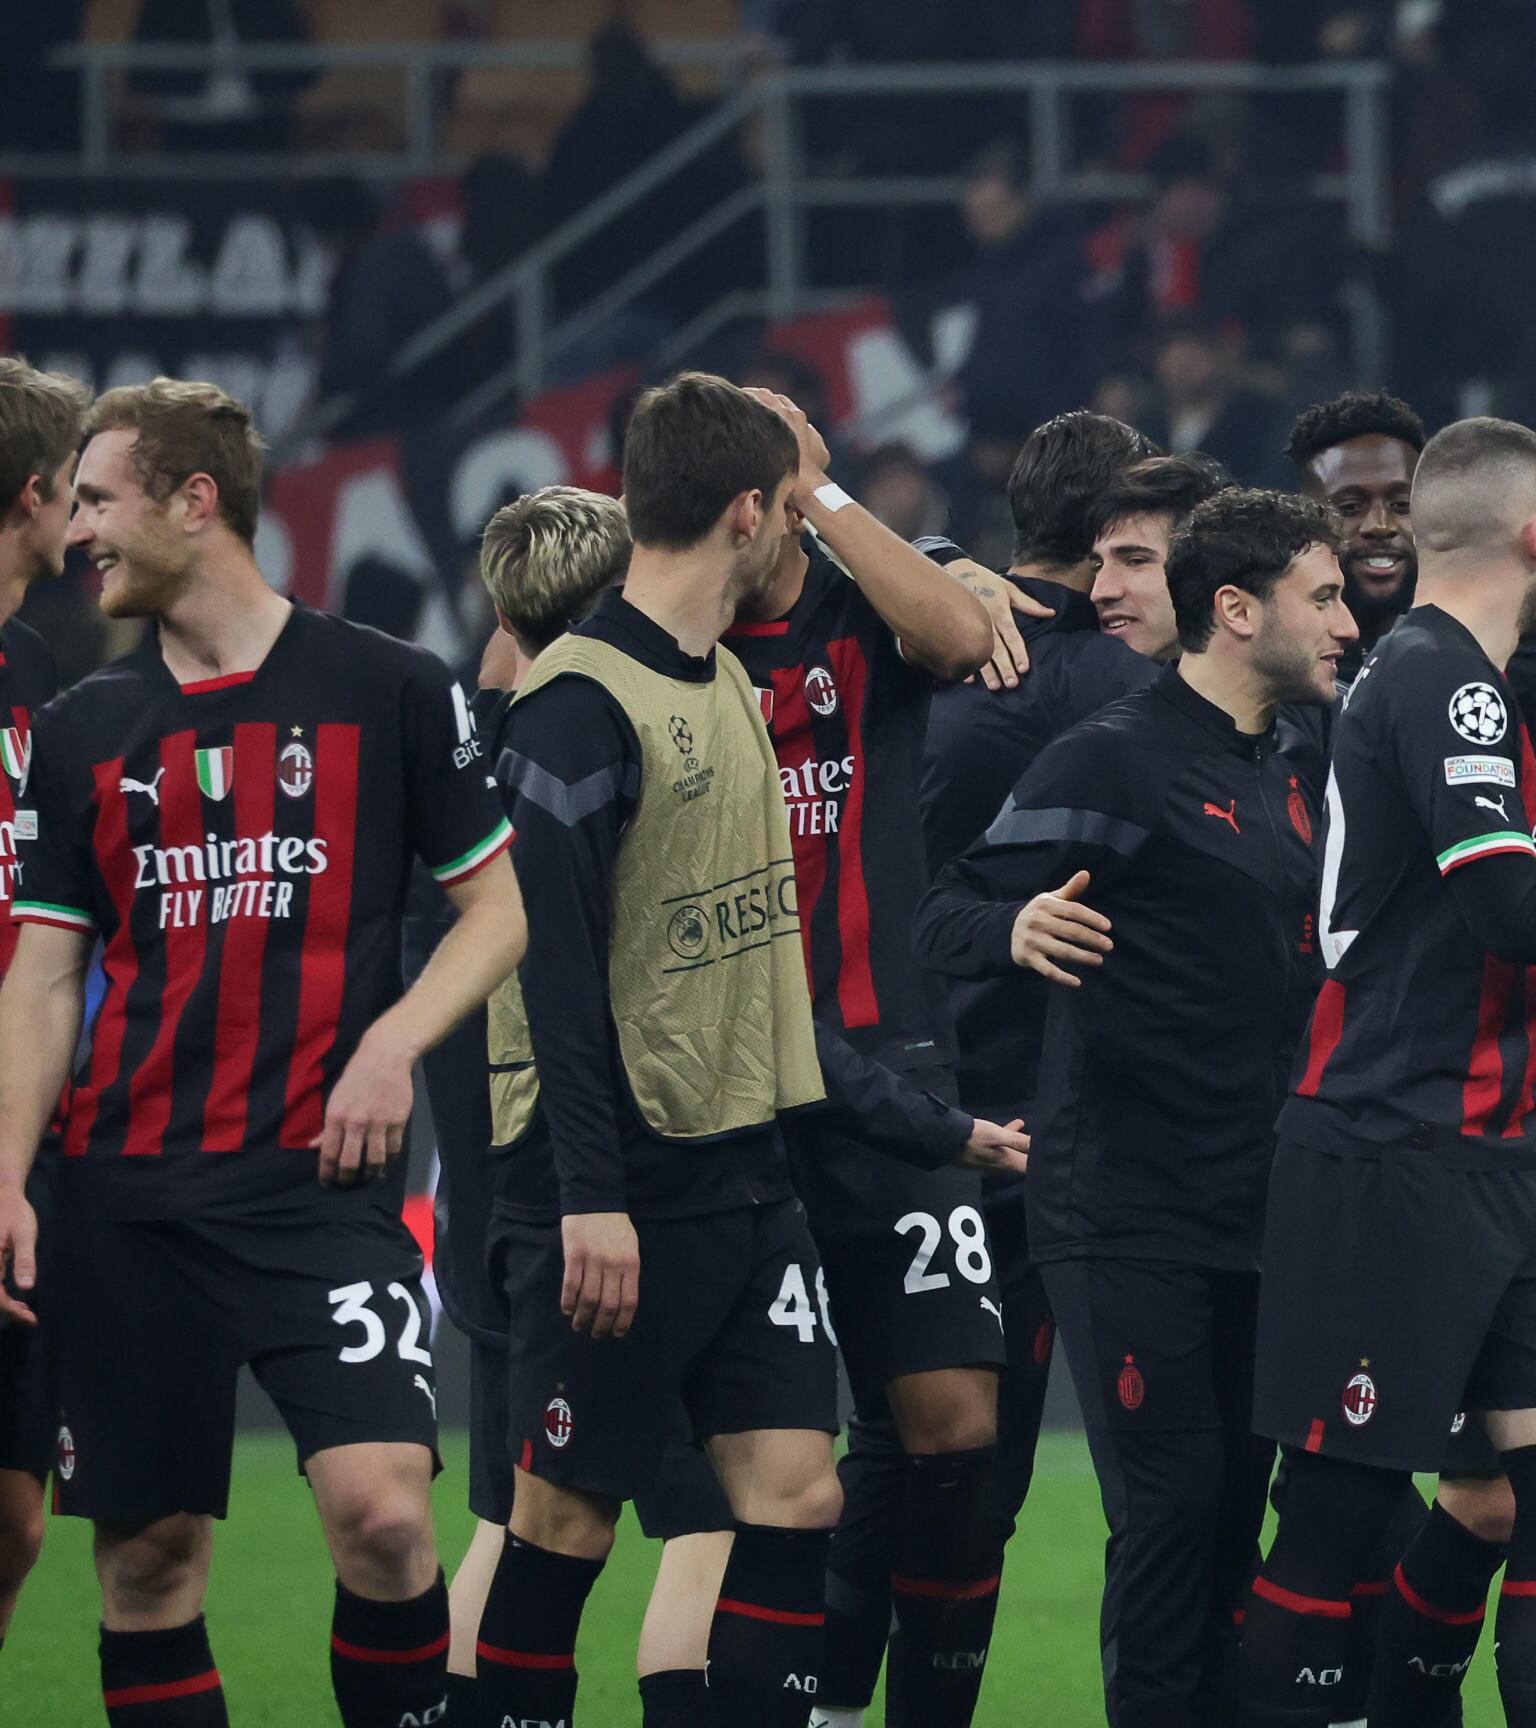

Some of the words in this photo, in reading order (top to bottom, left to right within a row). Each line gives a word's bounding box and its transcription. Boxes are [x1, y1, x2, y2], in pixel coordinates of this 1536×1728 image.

[1447, 764, 1514, 778] FOUNDATION
[785, 801, 838, 836] TTER
[132, 830, 328, 889] Emirates
[160, 890, 203, 929] FLY
[211, 881, 294, 923] BETTER
[894, 1205, 992, 1294] 28
[328, 1281, 433, 1367] 32
